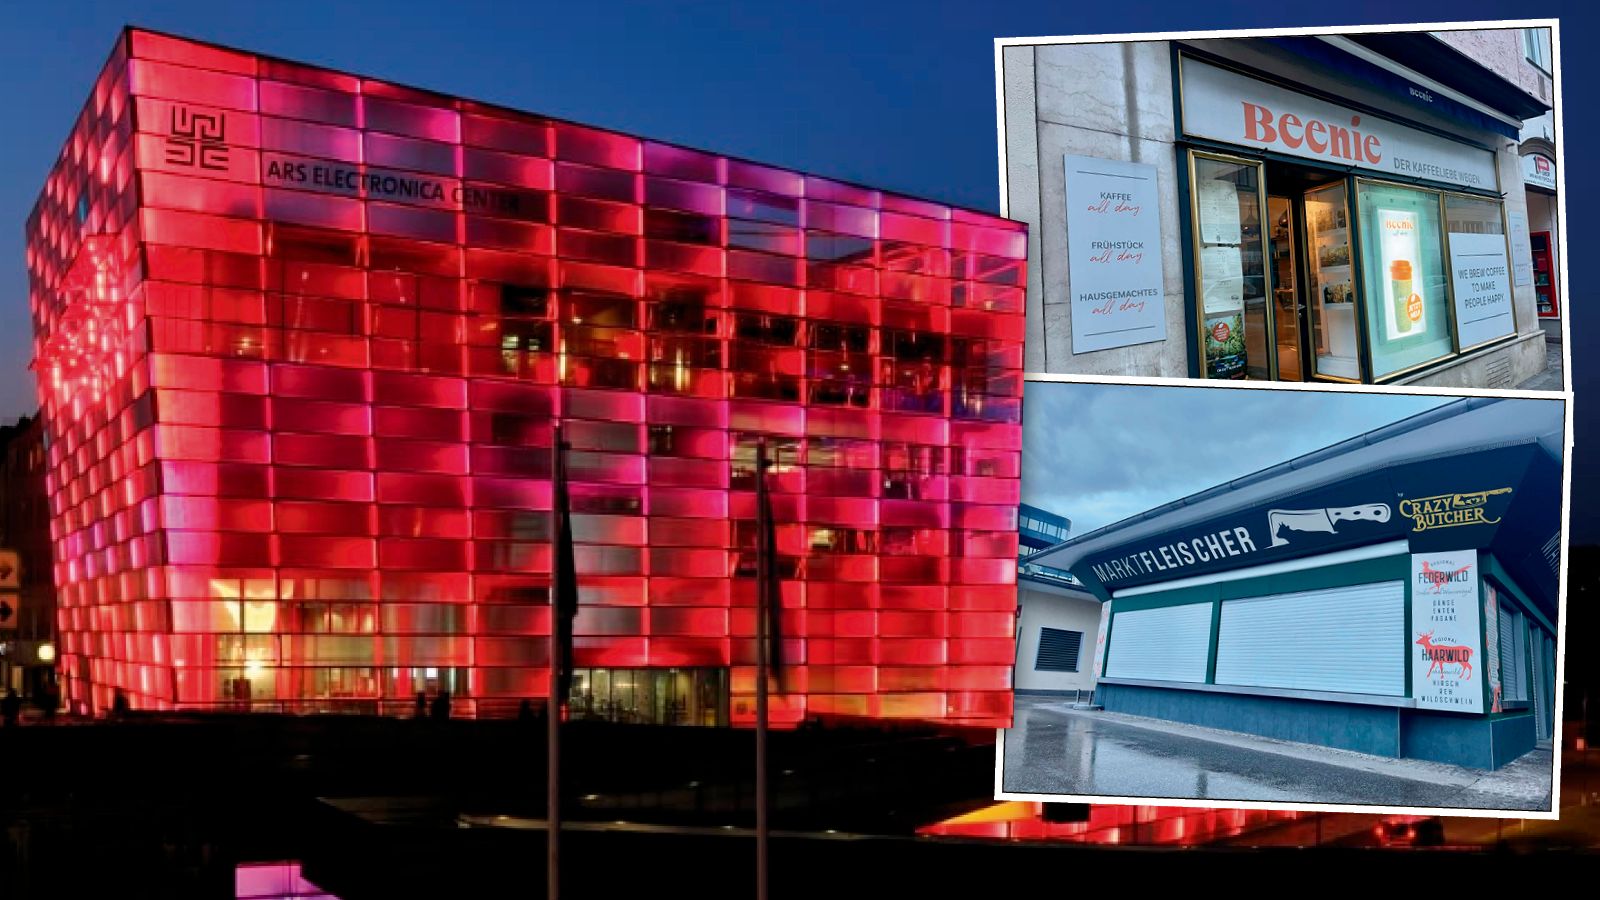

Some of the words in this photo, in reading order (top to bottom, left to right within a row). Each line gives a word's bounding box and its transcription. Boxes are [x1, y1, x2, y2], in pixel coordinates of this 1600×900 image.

[1241, 101, 1382, 165] Beenie
[1393, 157, 1411, 172] DER
[1412, 161, 1458, 181] KAFFEELIEBE
[267, 160, 308, 182] ARS
[312, 167, 446, 201] ELECTRONICA
[451, 186, 520, 211] CENTER
[1100, 192, 1132, 201] KAFFEE
[1087, 200, 1111, 214] all
[1114, 200, 1141, 217] day
[1091, 240, 1144, 250] FRÜHSTÜCK
[1089, 248, 1112, 263] all
[1117, 249, 1143, 264] day
[1458, 269, 1468, 280] WE
[1469, 268, 1485, 279] BREW
[1486, 266, 1505, 277] COFFEE
[1471, 283, 1480, 292] TO
[1480, 281, 1496, 292] MAKE
[1080, 289, 1158, 302] HAUSGEMACHTES
[1465, 296, 1487, 309] PEOPLE
[1091, 299, 1115, 315] all
[1119, 298, 1145, 312] day
[1399, 496, 1453, 518] CRAZY
[1411, 507, 1502, 532] BUTCHER
[1092, 526, 1257, 583] MARKTFLEISCHER
[1418, 570, 1468, 584] FEDERWILD
[1421, 648, 1470, 663] HAARWILD
[1421, 696, 1473, 705] WILDSCHWEIN
